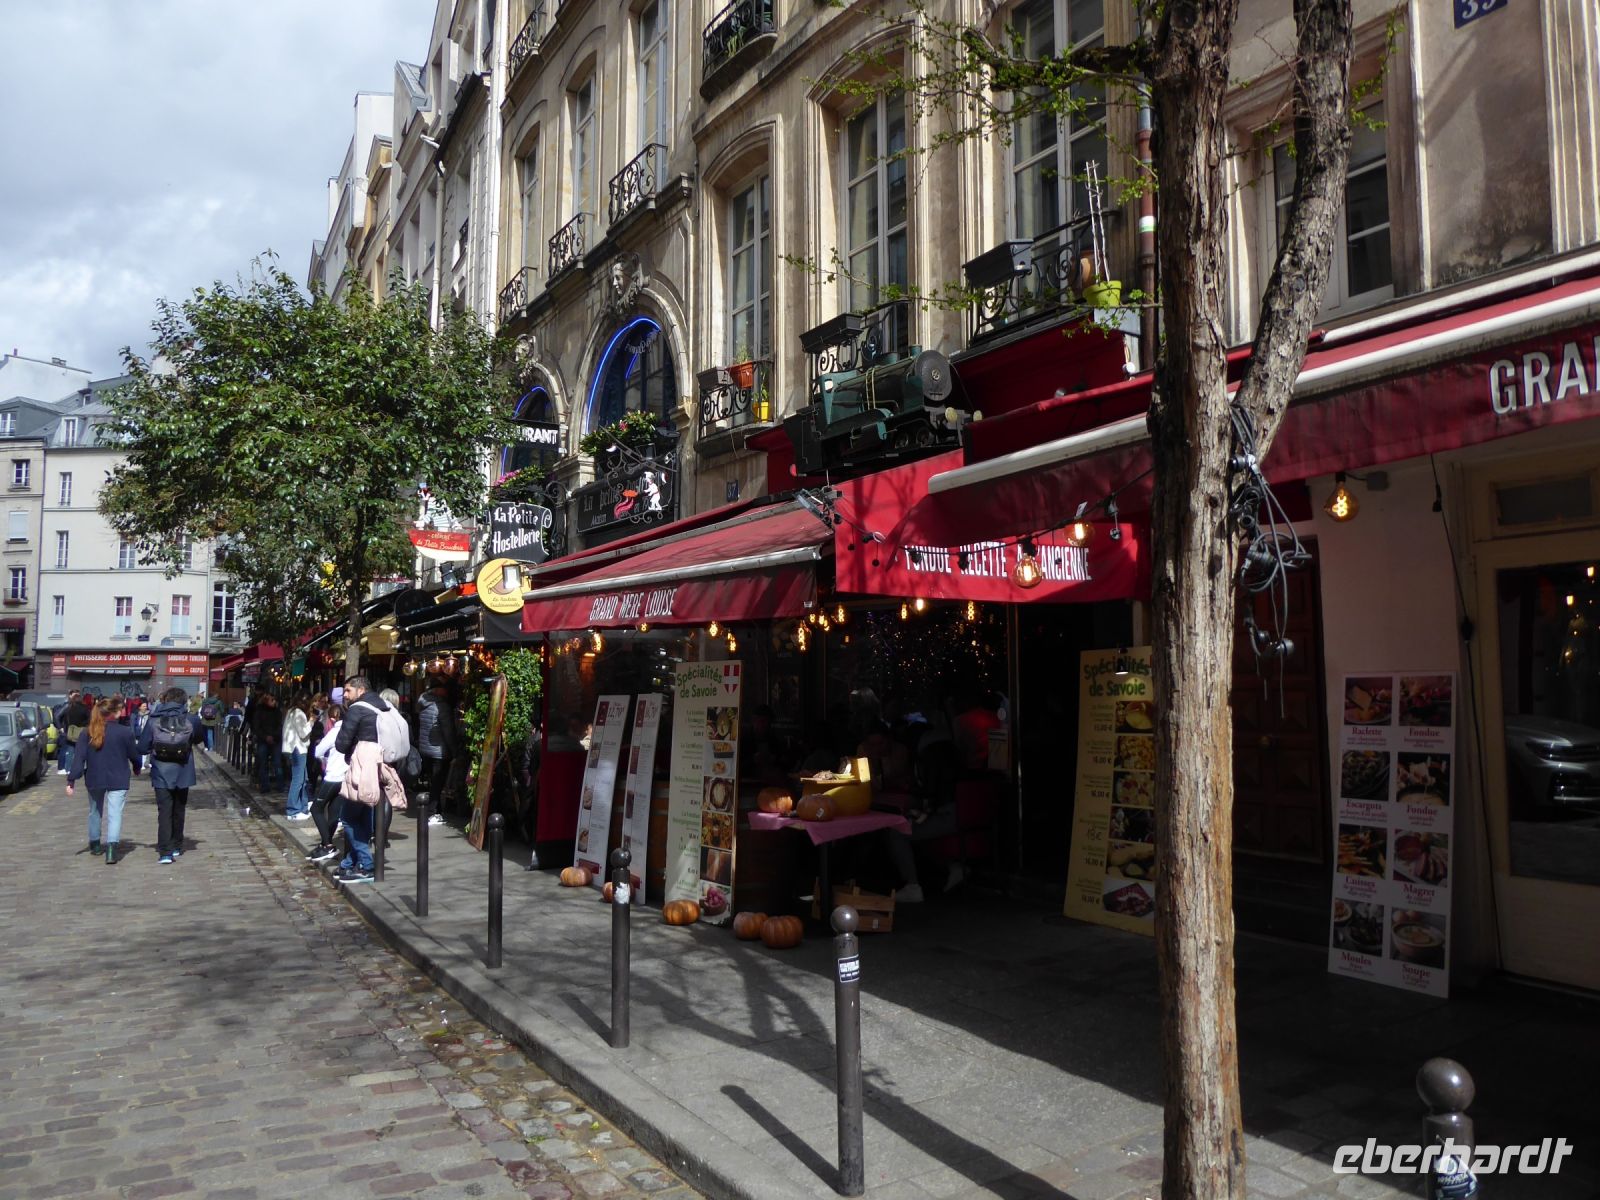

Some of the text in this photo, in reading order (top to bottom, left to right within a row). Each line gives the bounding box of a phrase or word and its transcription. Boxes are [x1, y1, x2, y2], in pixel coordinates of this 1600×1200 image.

[1490, 336, 1600, 414] GRA
[493, 506, 539, 526] La Petite
[492, 528, 541, 555] Hostellerie
[590, 588, 678, 621] GRAND MERE LOUISE
[677, 664, 722, 688] Spécialités
[680, 683, 717, 698] de Savoie
[1089, 678, 1146, 698] de Savoie
[1409, 727, 1440, 738] Fondue
[1407, 804, 1438, 816] Fondue
[1403, 883, 1435, 897] Magret
[1341, 951, 1372, 966] Moules
[1402, 963, 1431, 979] Soupe
